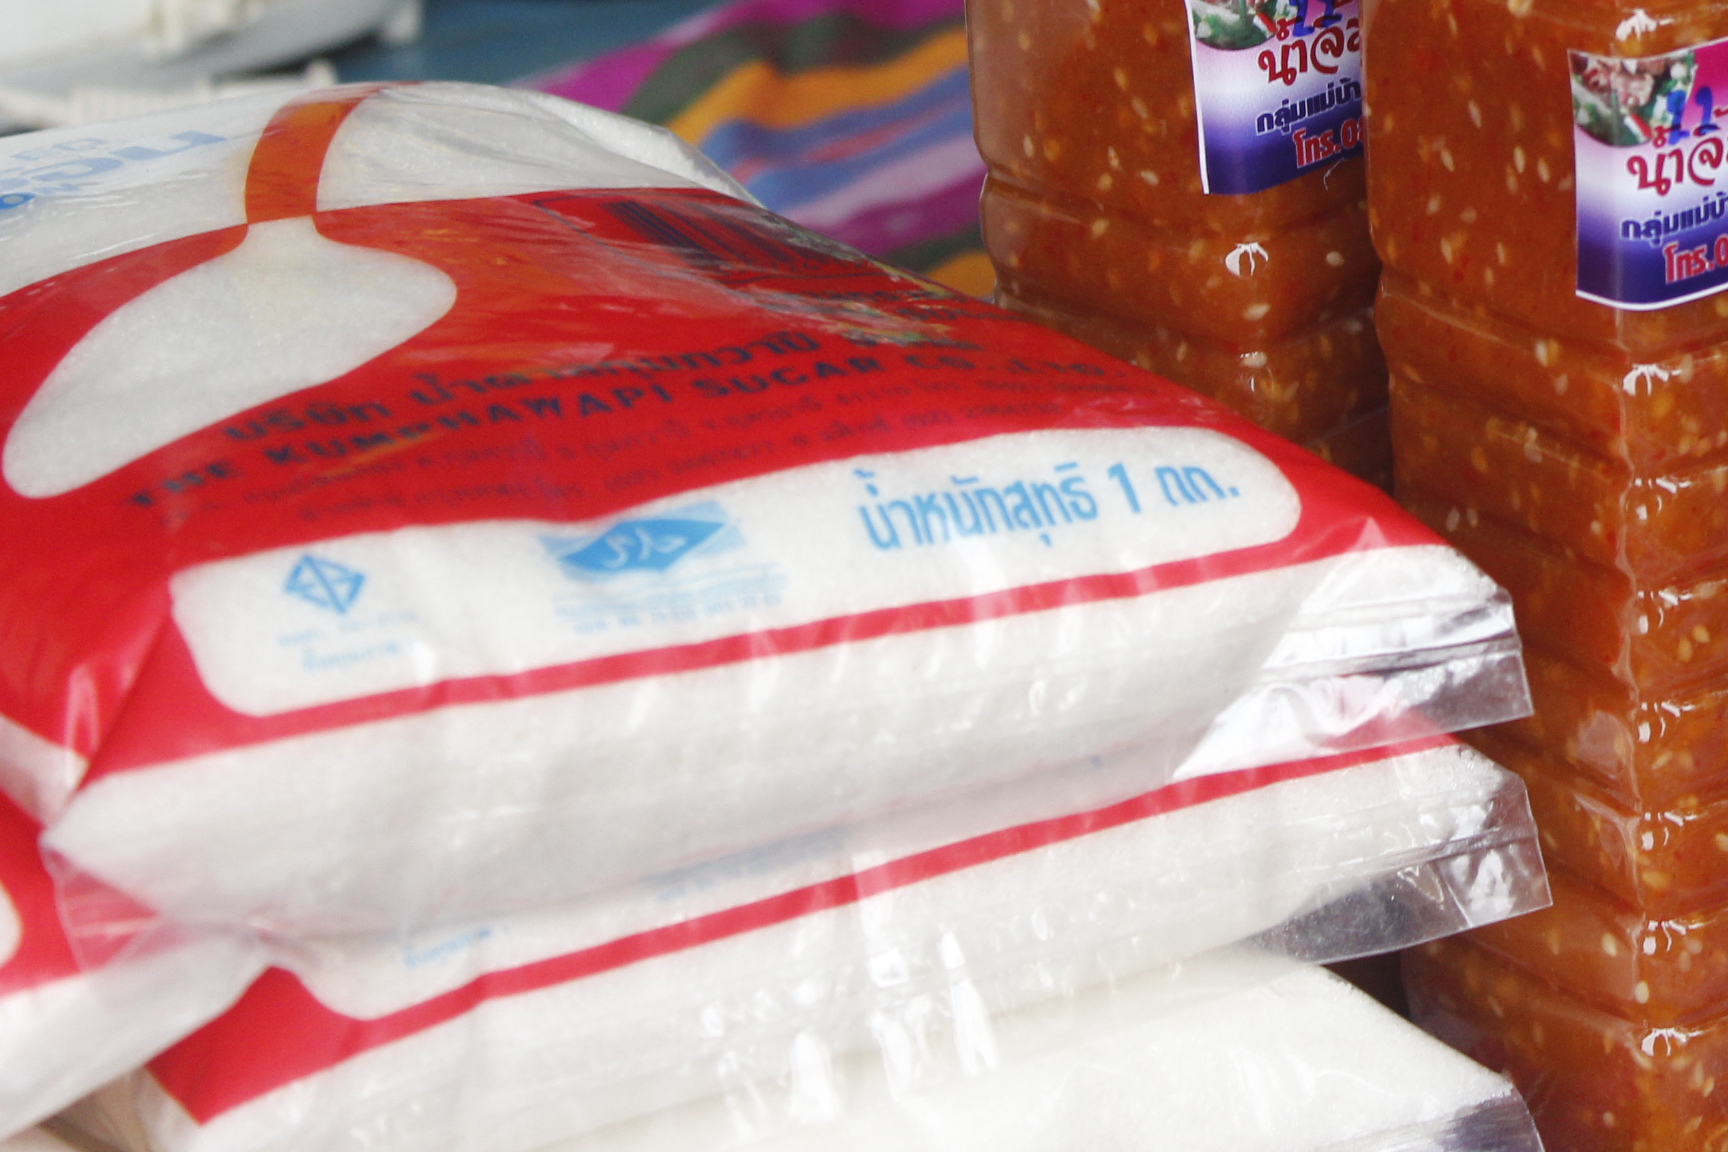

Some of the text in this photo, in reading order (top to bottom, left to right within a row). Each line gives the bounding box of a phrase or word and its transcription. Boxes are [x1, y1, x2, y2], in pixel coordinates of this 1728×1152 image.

[691, 352, 887, 400] SUGAR
[853, 462, 1240, 551] น้ำหนักสุทธิ 1 กก.
